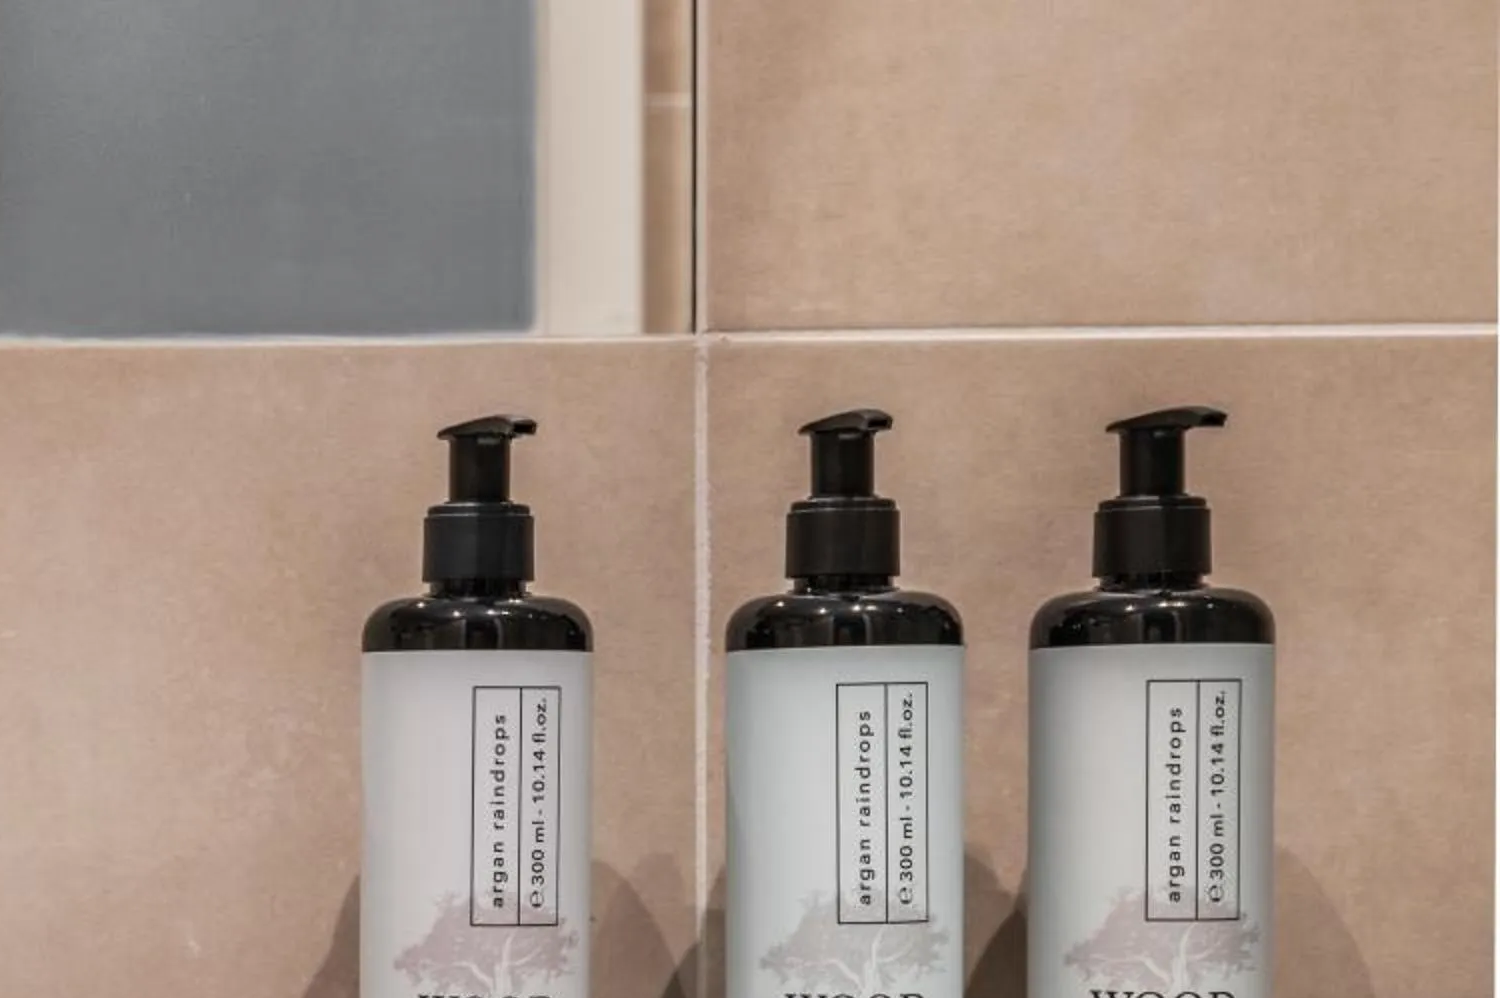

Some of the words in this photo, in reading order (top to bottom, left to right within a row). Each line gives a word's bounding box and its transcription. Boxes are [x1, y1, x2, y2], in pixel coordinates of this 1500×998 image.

[489, 715, 510, 831] raindrops
[531, 749, 546, 804] 10.14
[854, 711, 875, 827] raindrops
[899, 745, 913, 799] 10.14
[1165, 707, 1187, 824] raindrops
[1210, 742, 1225, 797] 10.14
[531, 820, 545, 843] ml
[899, 816, 913, 839] ml
[1209, 813, 1224, 837] ml
[492, 841, 509, 909] argan
[859, 839, 876, 906] argan
[1168, 835, 1186, 904] argan
